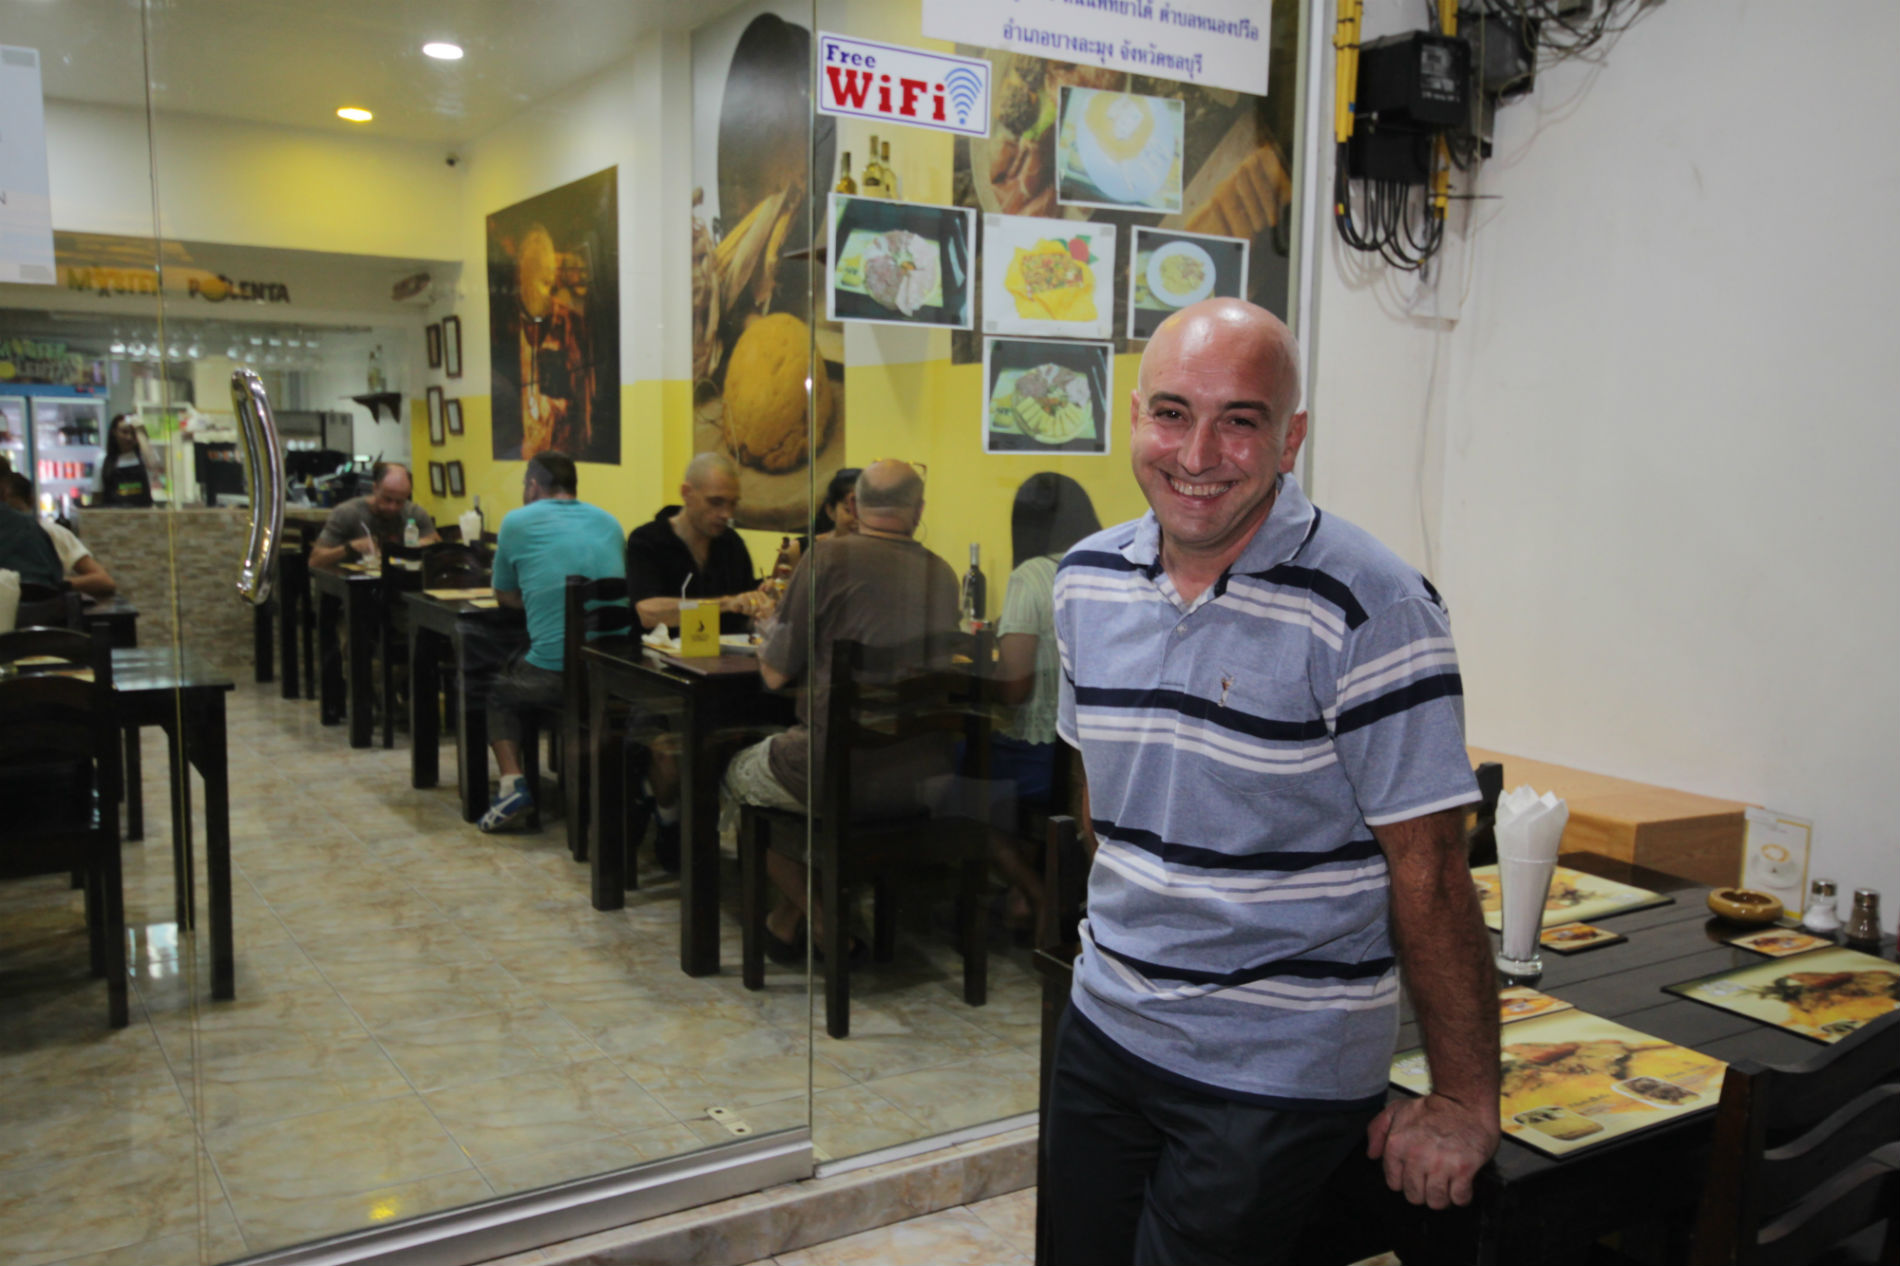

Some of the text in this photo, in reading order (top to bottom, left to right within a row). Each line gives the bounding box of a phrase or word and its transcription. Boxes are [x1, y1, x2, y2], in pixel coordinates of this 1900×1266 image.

[826, 43, 876, 69] Free
[1003, 18, 1203, 79] อำเภอบางละมุง จังหวัดชลบุรี
[826, 65, 947, 122] WiFi
[188, 273, 291, 304] POLENTA
